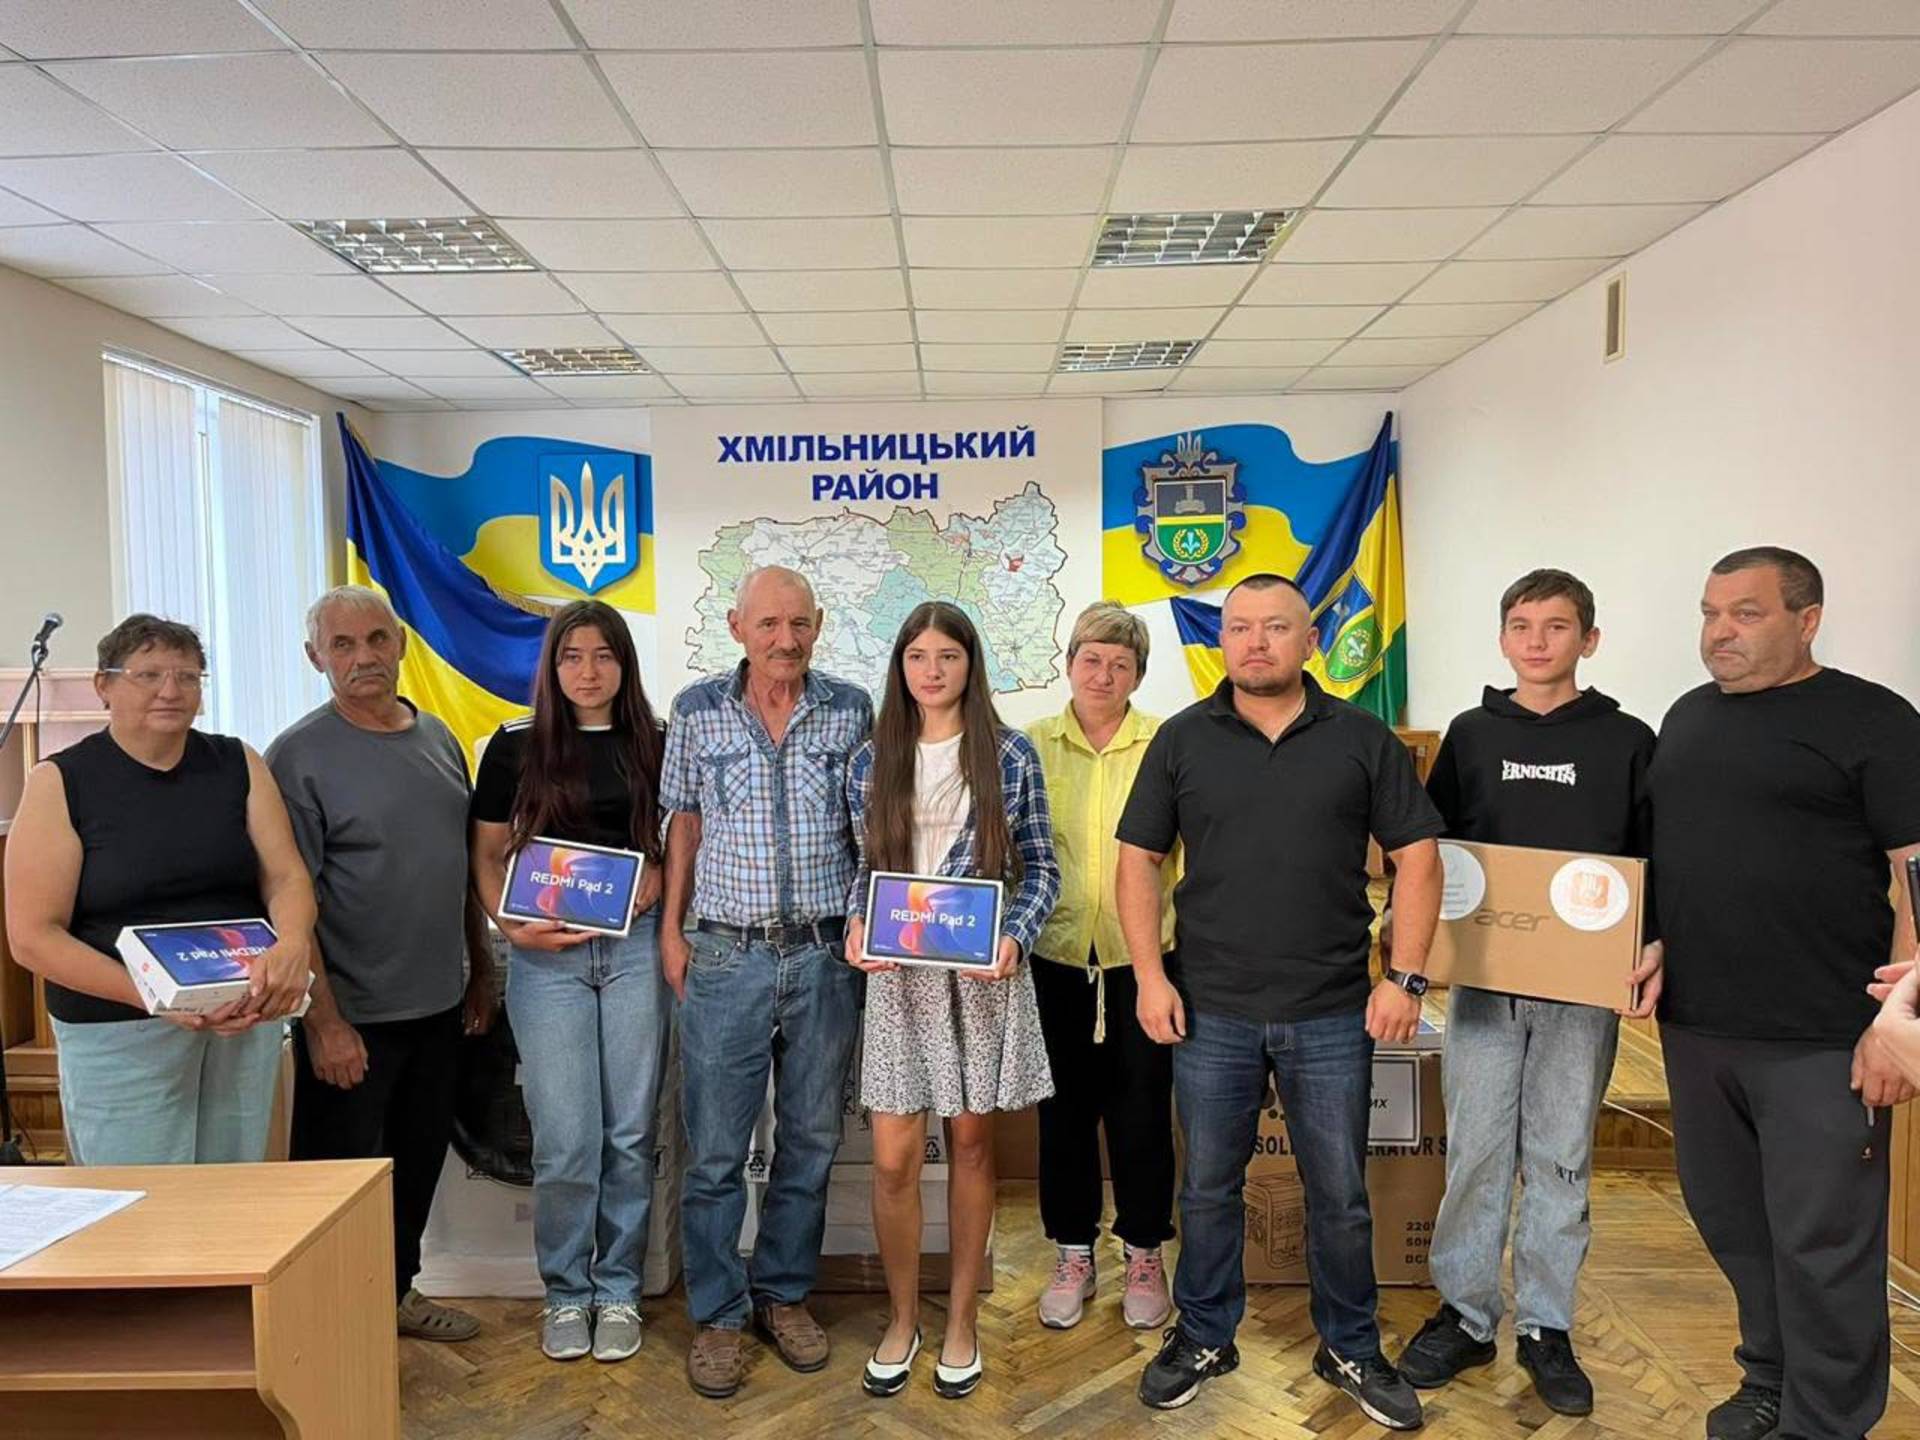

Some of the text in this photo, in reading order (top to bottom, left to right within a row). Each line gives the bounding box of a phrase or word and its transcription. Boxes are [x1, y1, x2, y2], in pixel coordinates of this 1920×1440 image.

[717, 425, 1036, 465] ХМІЛЬНИЦЬКИЙ
[812, 468, 939, 501] РАЙОН
[578, 878, 602, 893] Pad
[604, 882, 614, 895] 2
[939, 912, 964, 926] Pad
[966, 915, 976, 927] 2
[1473, 908, 1550, 931] acer
